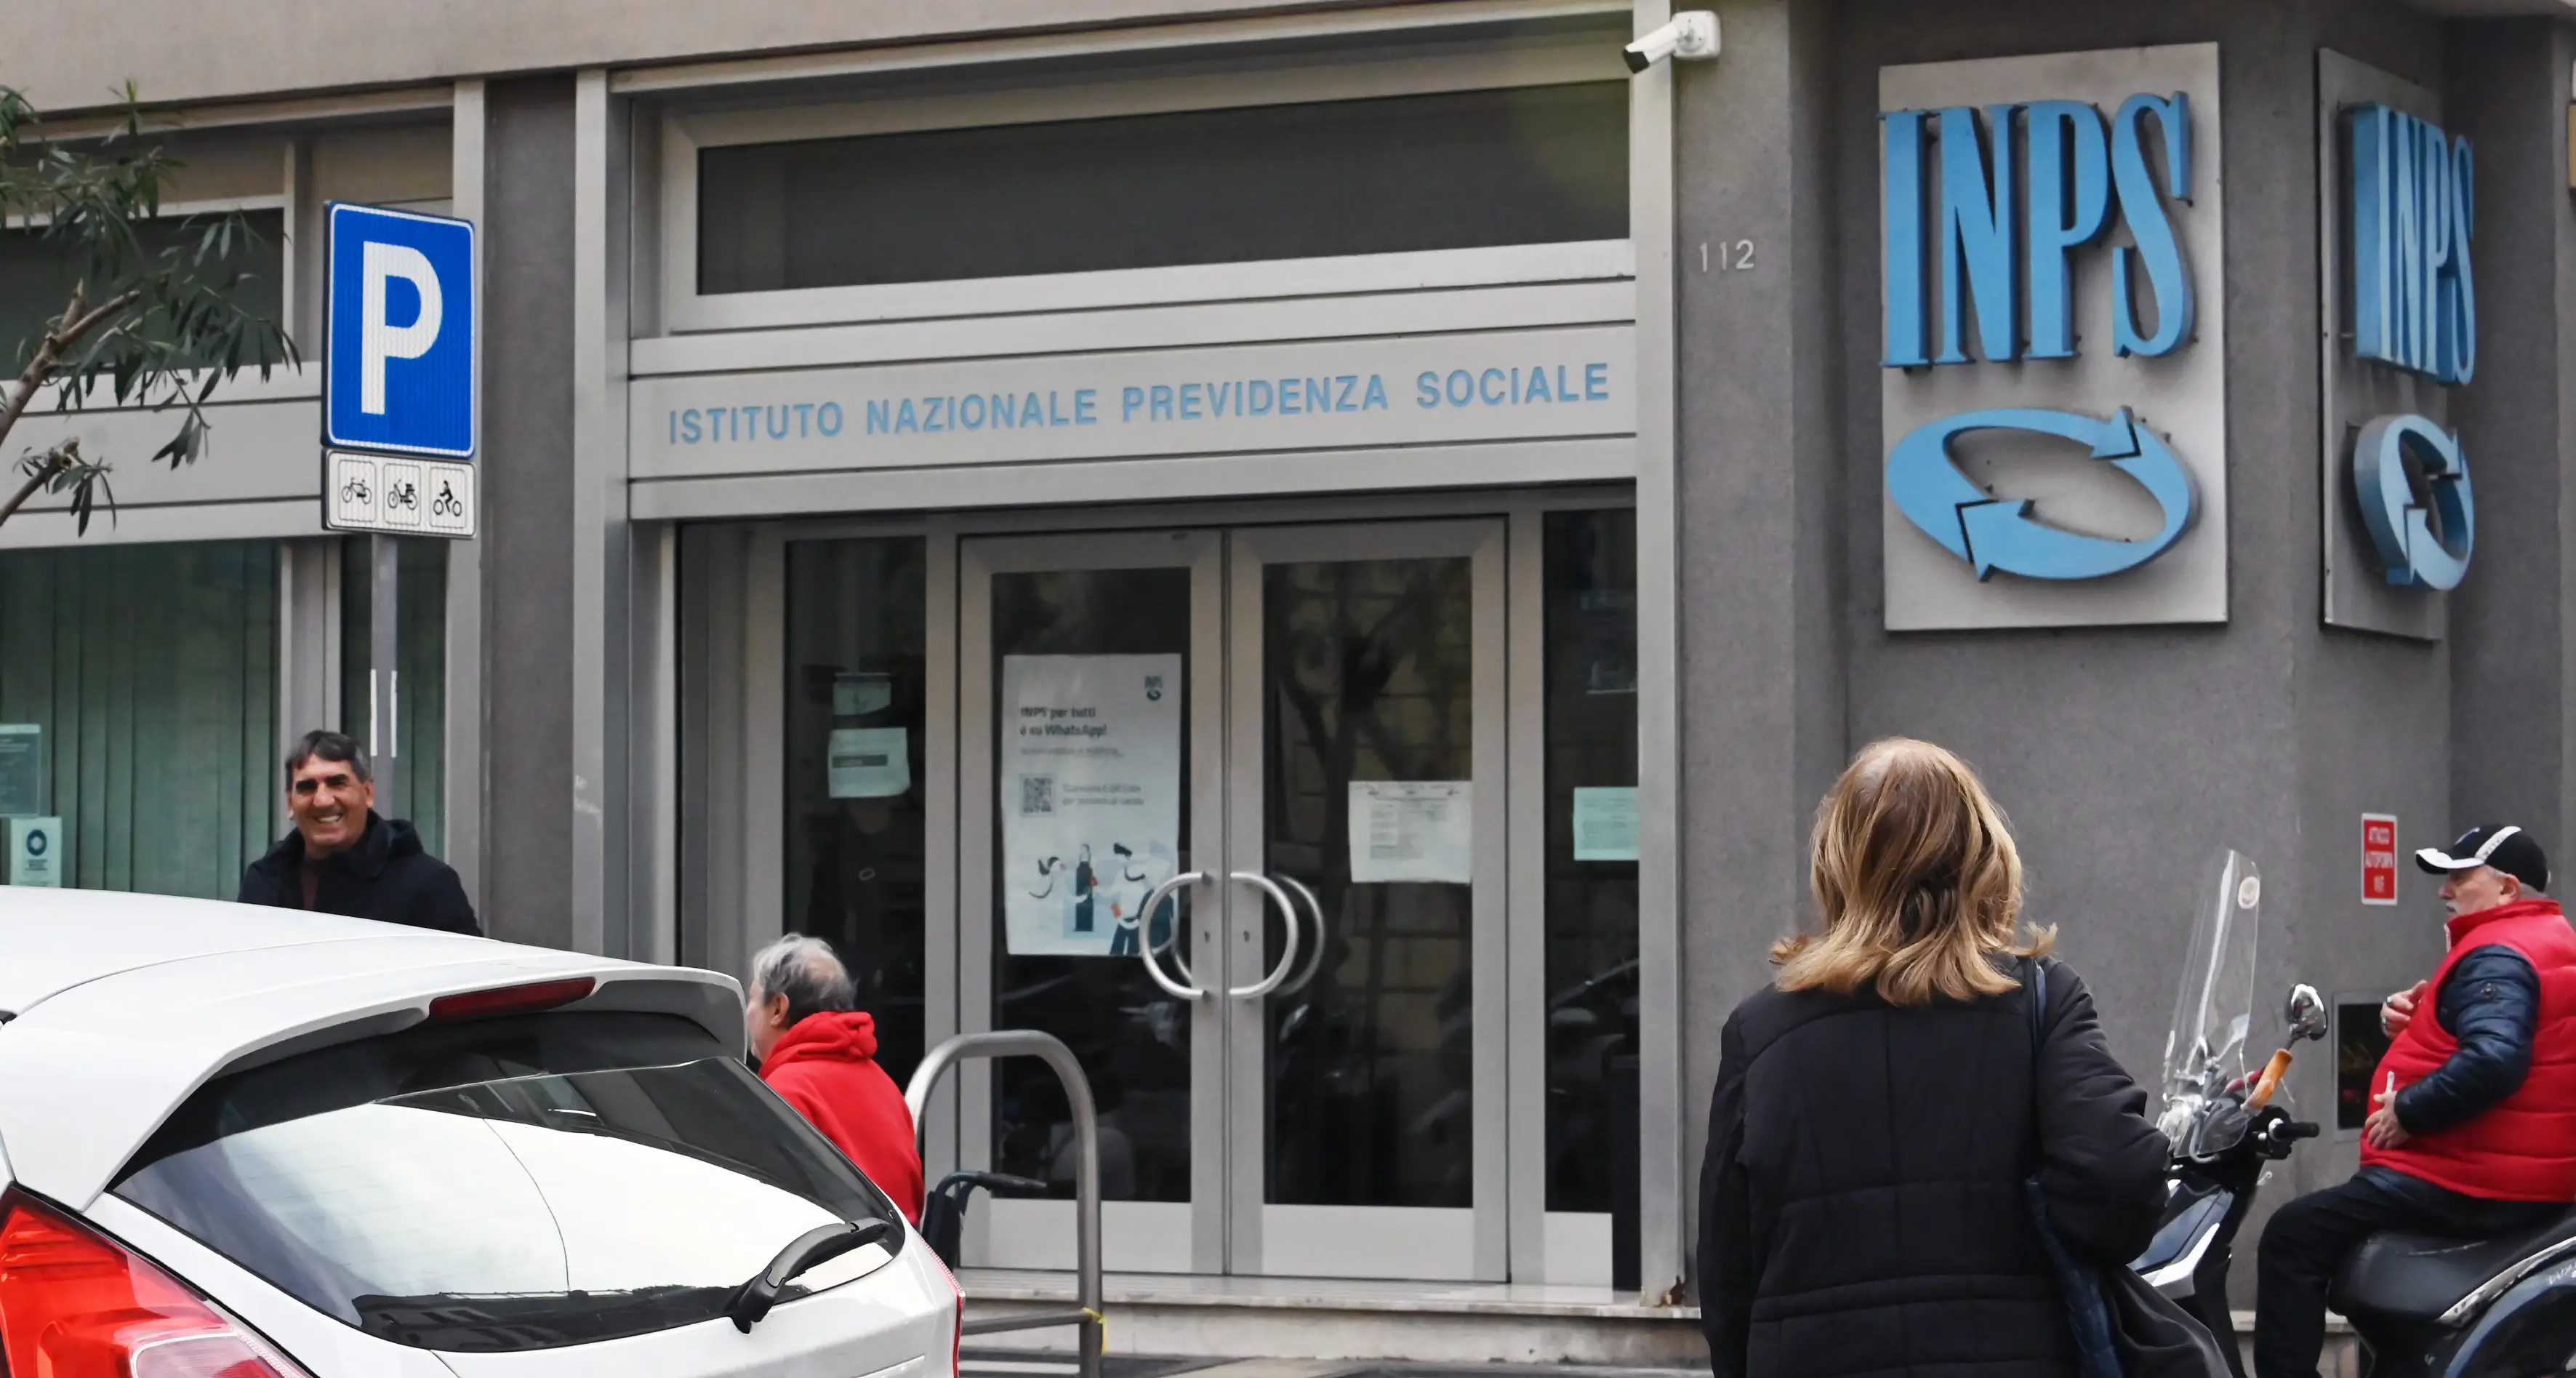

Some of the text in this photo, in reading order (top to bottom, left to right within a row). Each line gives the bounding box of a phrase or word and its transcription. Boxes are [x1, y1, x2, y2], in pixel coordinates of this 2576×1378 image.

[1699, 239, 1754, 273] 112
[1878, 90, 2194, 368] INPS
[2356, 103, 2476, 385] INPS
[361, 241, 443, 414] P
[669, 363, 1609, 445] ISTITUTO NAZIONALE PREVIDENZA SOCIALE
[1021, 706, 1047, 718] INPS
